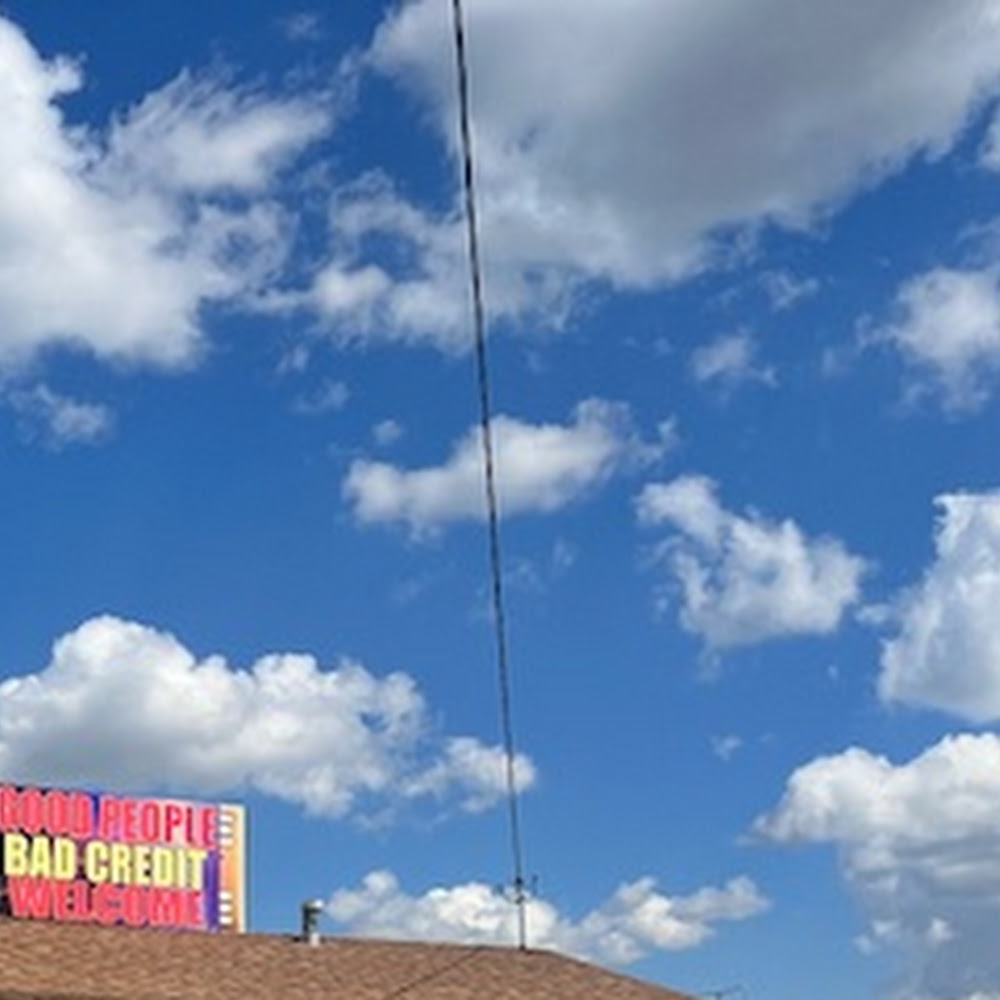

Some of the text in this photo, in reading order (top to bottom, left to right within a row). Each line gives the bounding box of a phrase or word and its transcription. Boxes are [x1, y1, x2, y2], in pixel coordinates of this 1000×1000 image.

[100, 796, 219, 850] PEOPLE
[4, 832, 78, 881] BAD
[86, 841, 208, 890] CREDIT
[7, 876, 208, 928] WELCOME
